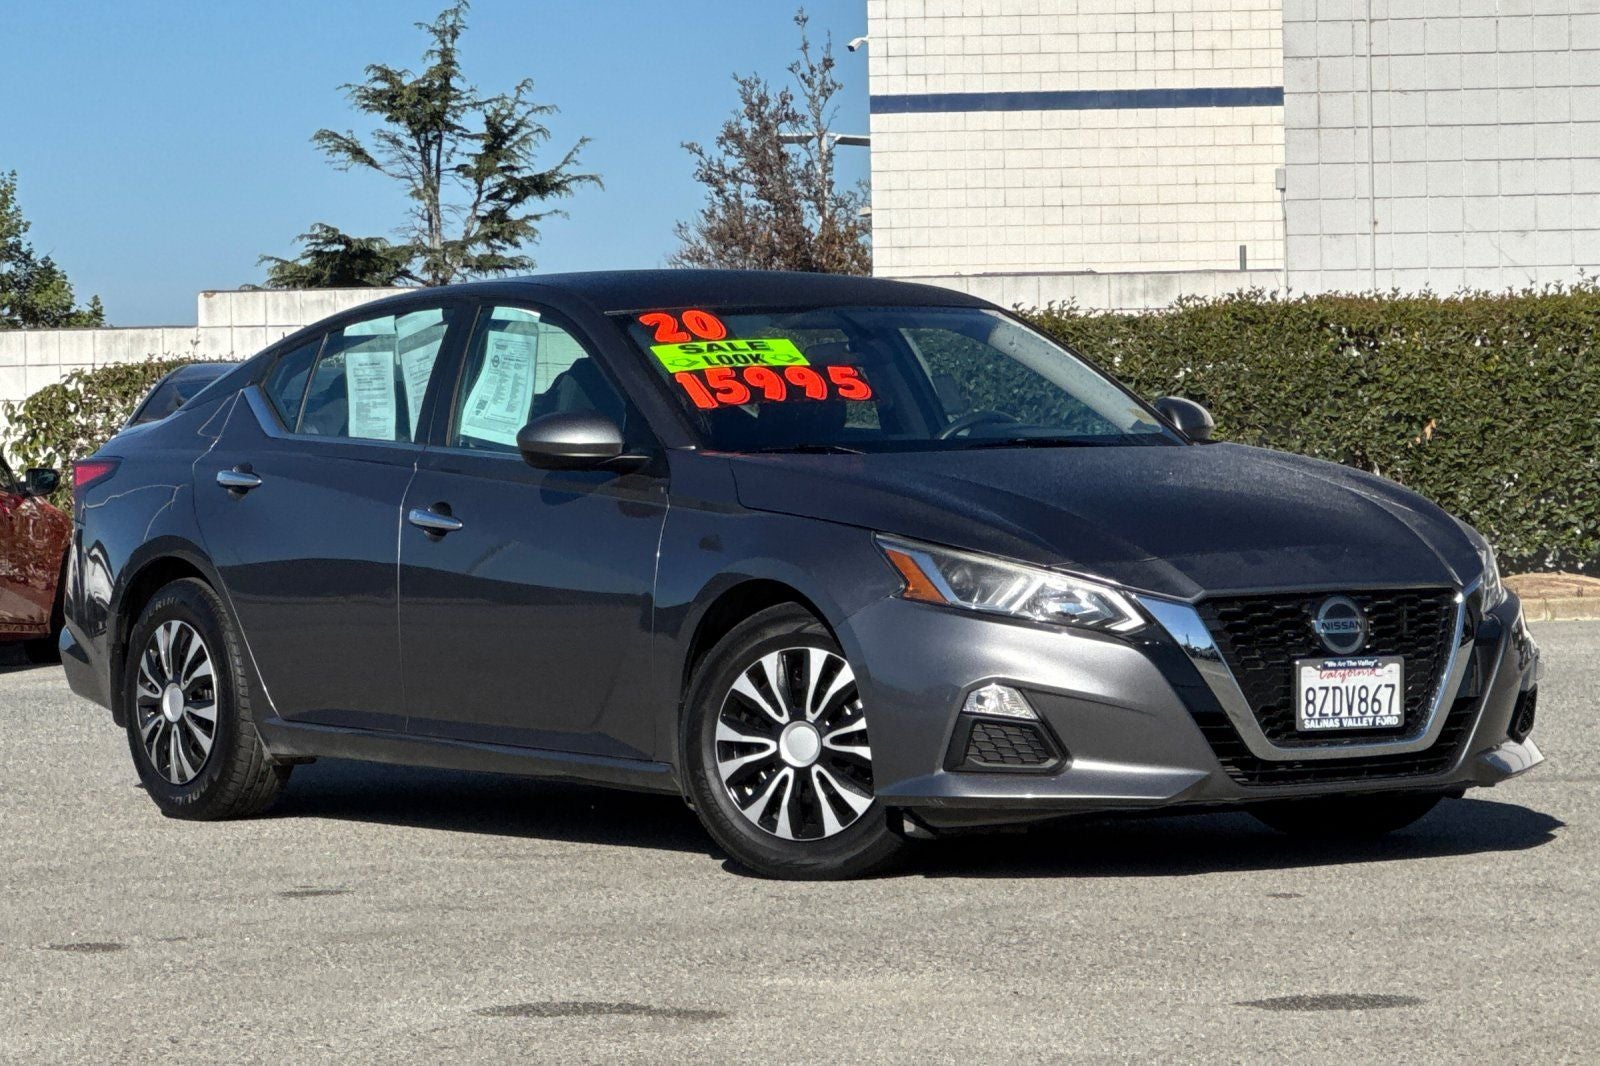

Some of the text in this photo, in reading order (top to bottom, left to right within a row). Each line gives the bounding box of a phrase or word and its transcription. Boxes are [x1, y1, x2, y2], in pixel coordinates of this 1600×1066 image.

[639, 310, 726, 343] 20
[678, 340, 772, 355] SALE
[702, 353, 769, 366] LOOK
[675, 365, 872, 409] 15995
[1321, 620, 1364, 631] NISSAN
[1319, 667, 1383, 684] California
[1305, 684, 1396, 718] 8ZDV867
[1304, 715, 1399, 729] SALINAS VALLEY FORD
